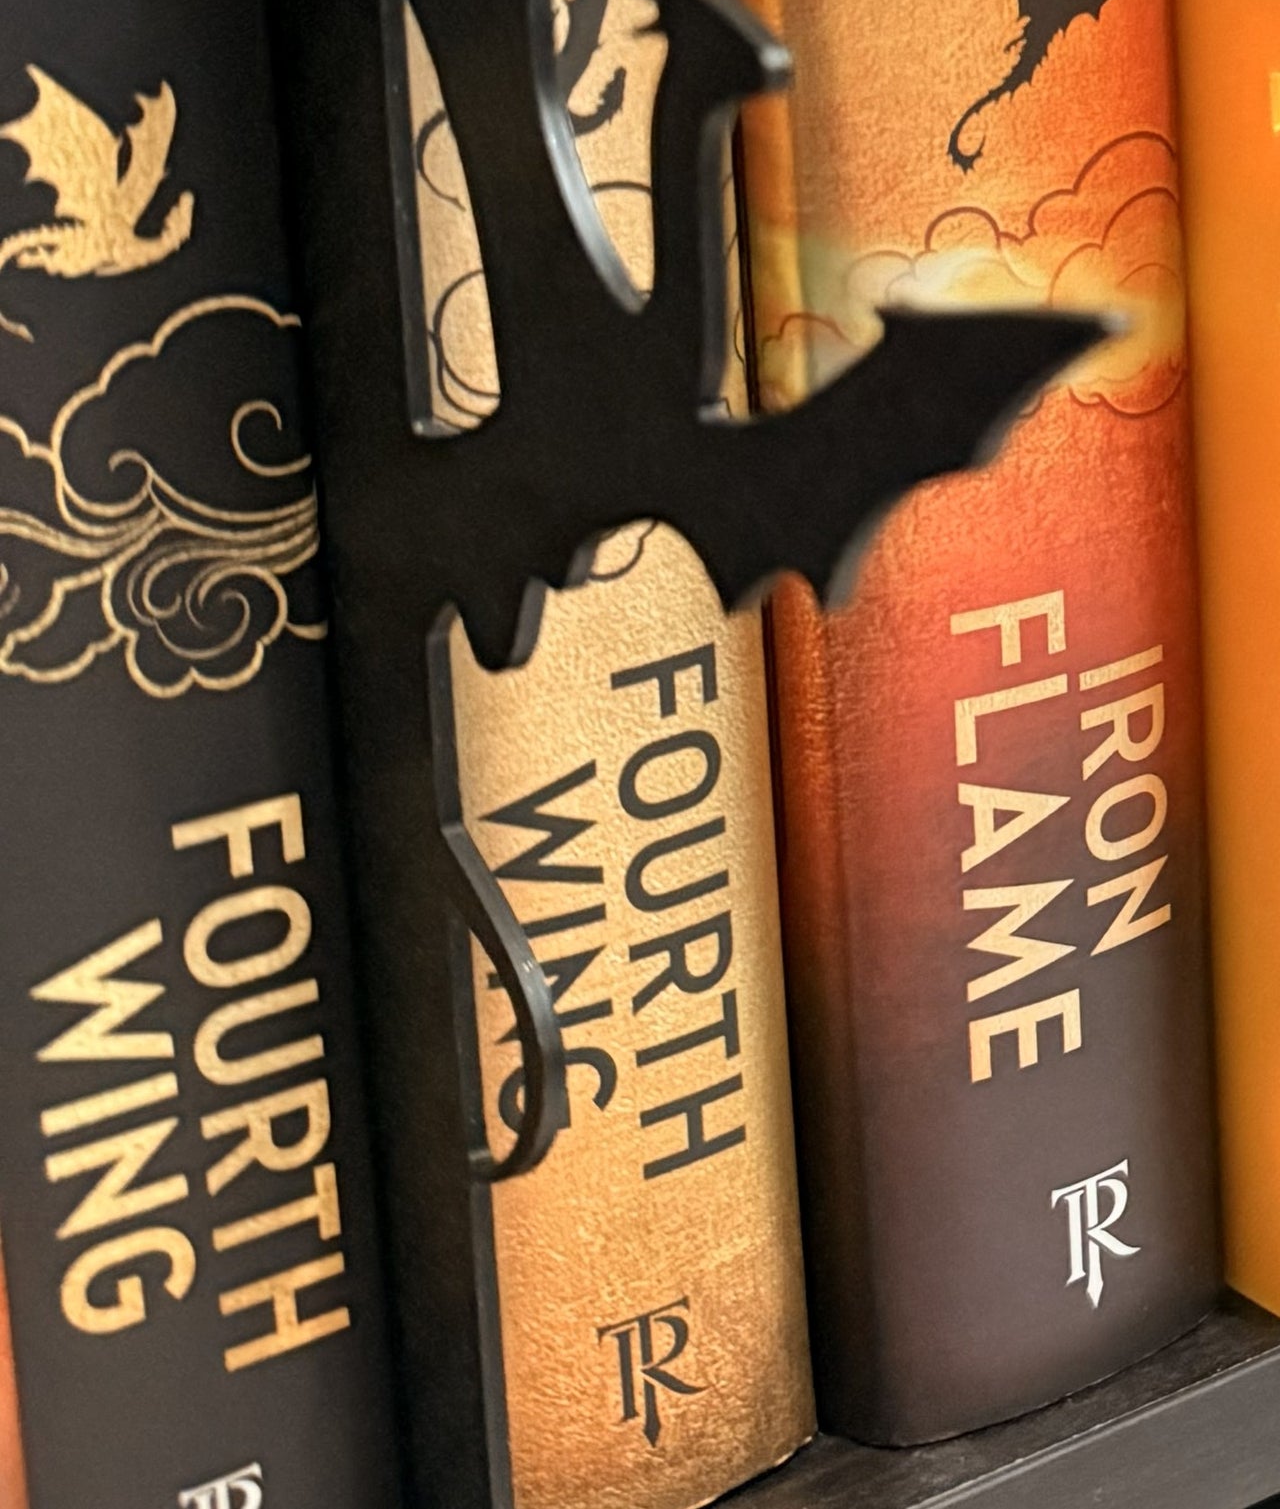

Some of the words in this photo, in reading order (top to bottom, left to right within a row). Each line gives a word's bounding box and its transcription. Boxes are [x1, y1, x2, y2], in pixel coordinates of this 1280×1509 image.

[610, 642, 747, 1181] FOURTH
[950, 589, 1082, 1085] FLAME
[1079, 643, 1171, 956] IRON
[30, 917, 197, 1335] WING
[171, 792, 350, 1373] FOURTH
